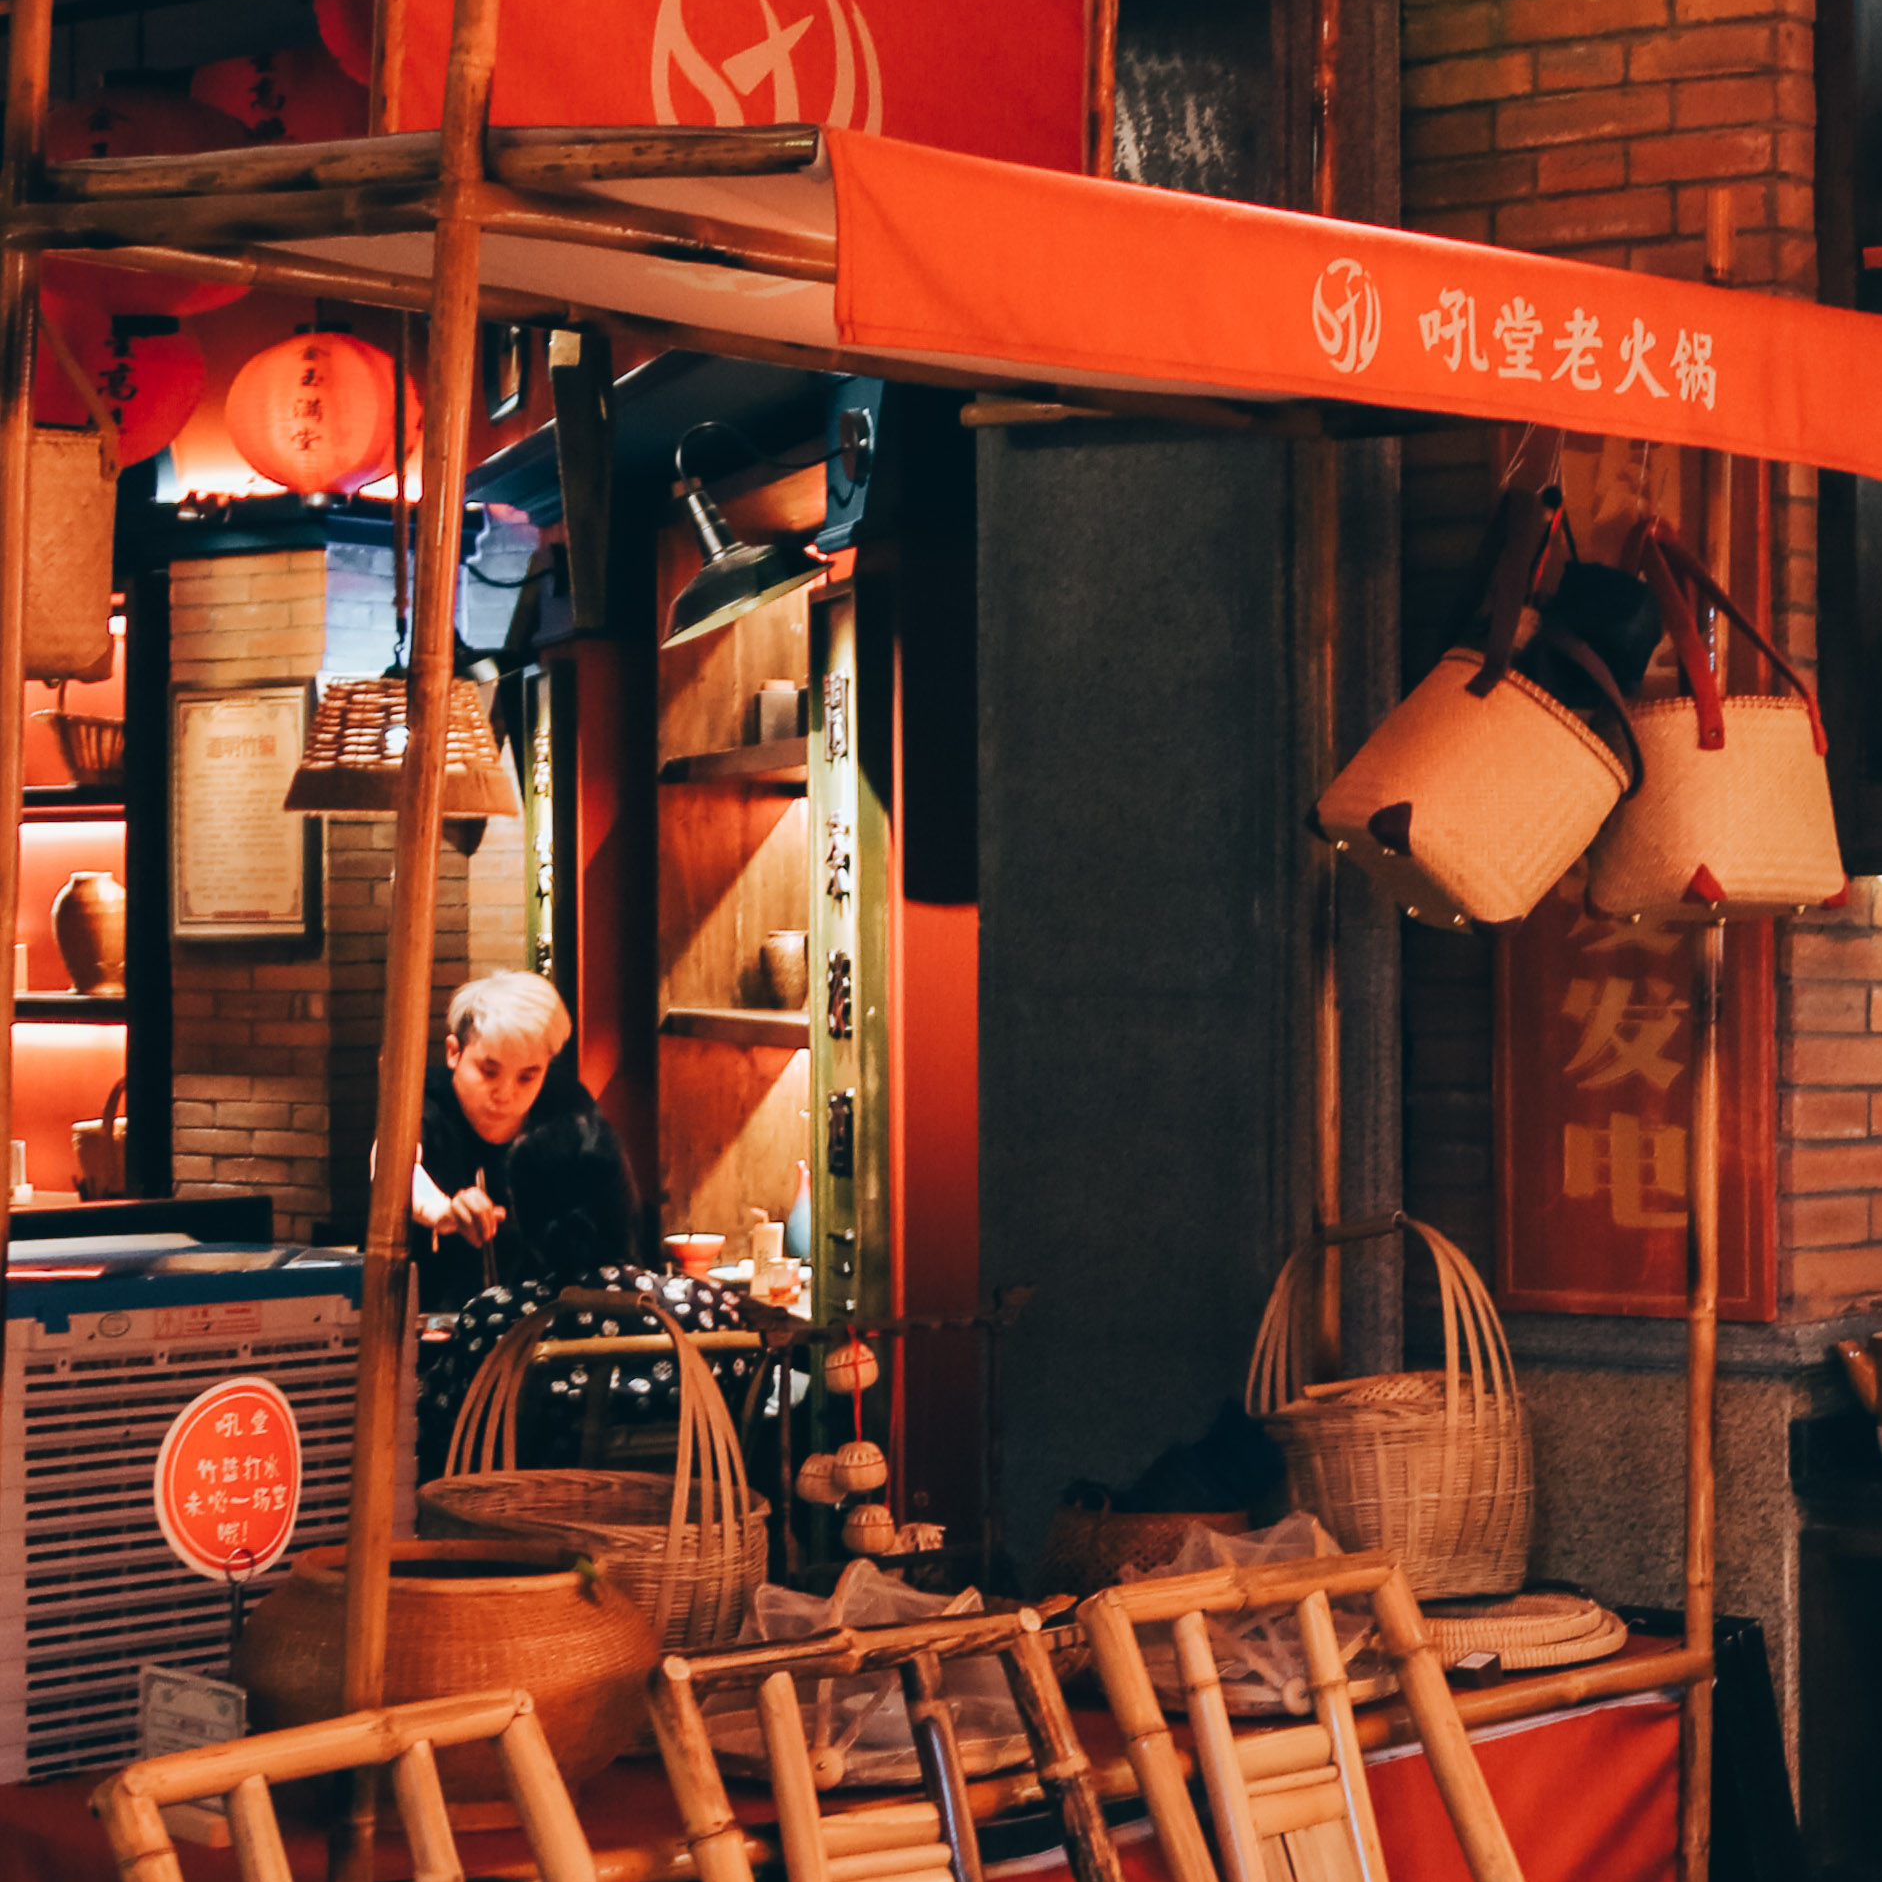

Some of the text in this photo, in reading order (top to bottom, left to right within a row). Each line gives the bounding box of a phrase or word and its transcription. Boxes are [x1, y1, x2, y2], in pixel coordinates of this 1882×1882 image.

[1418, 286, 1717, 411] 吼堂老火锅
